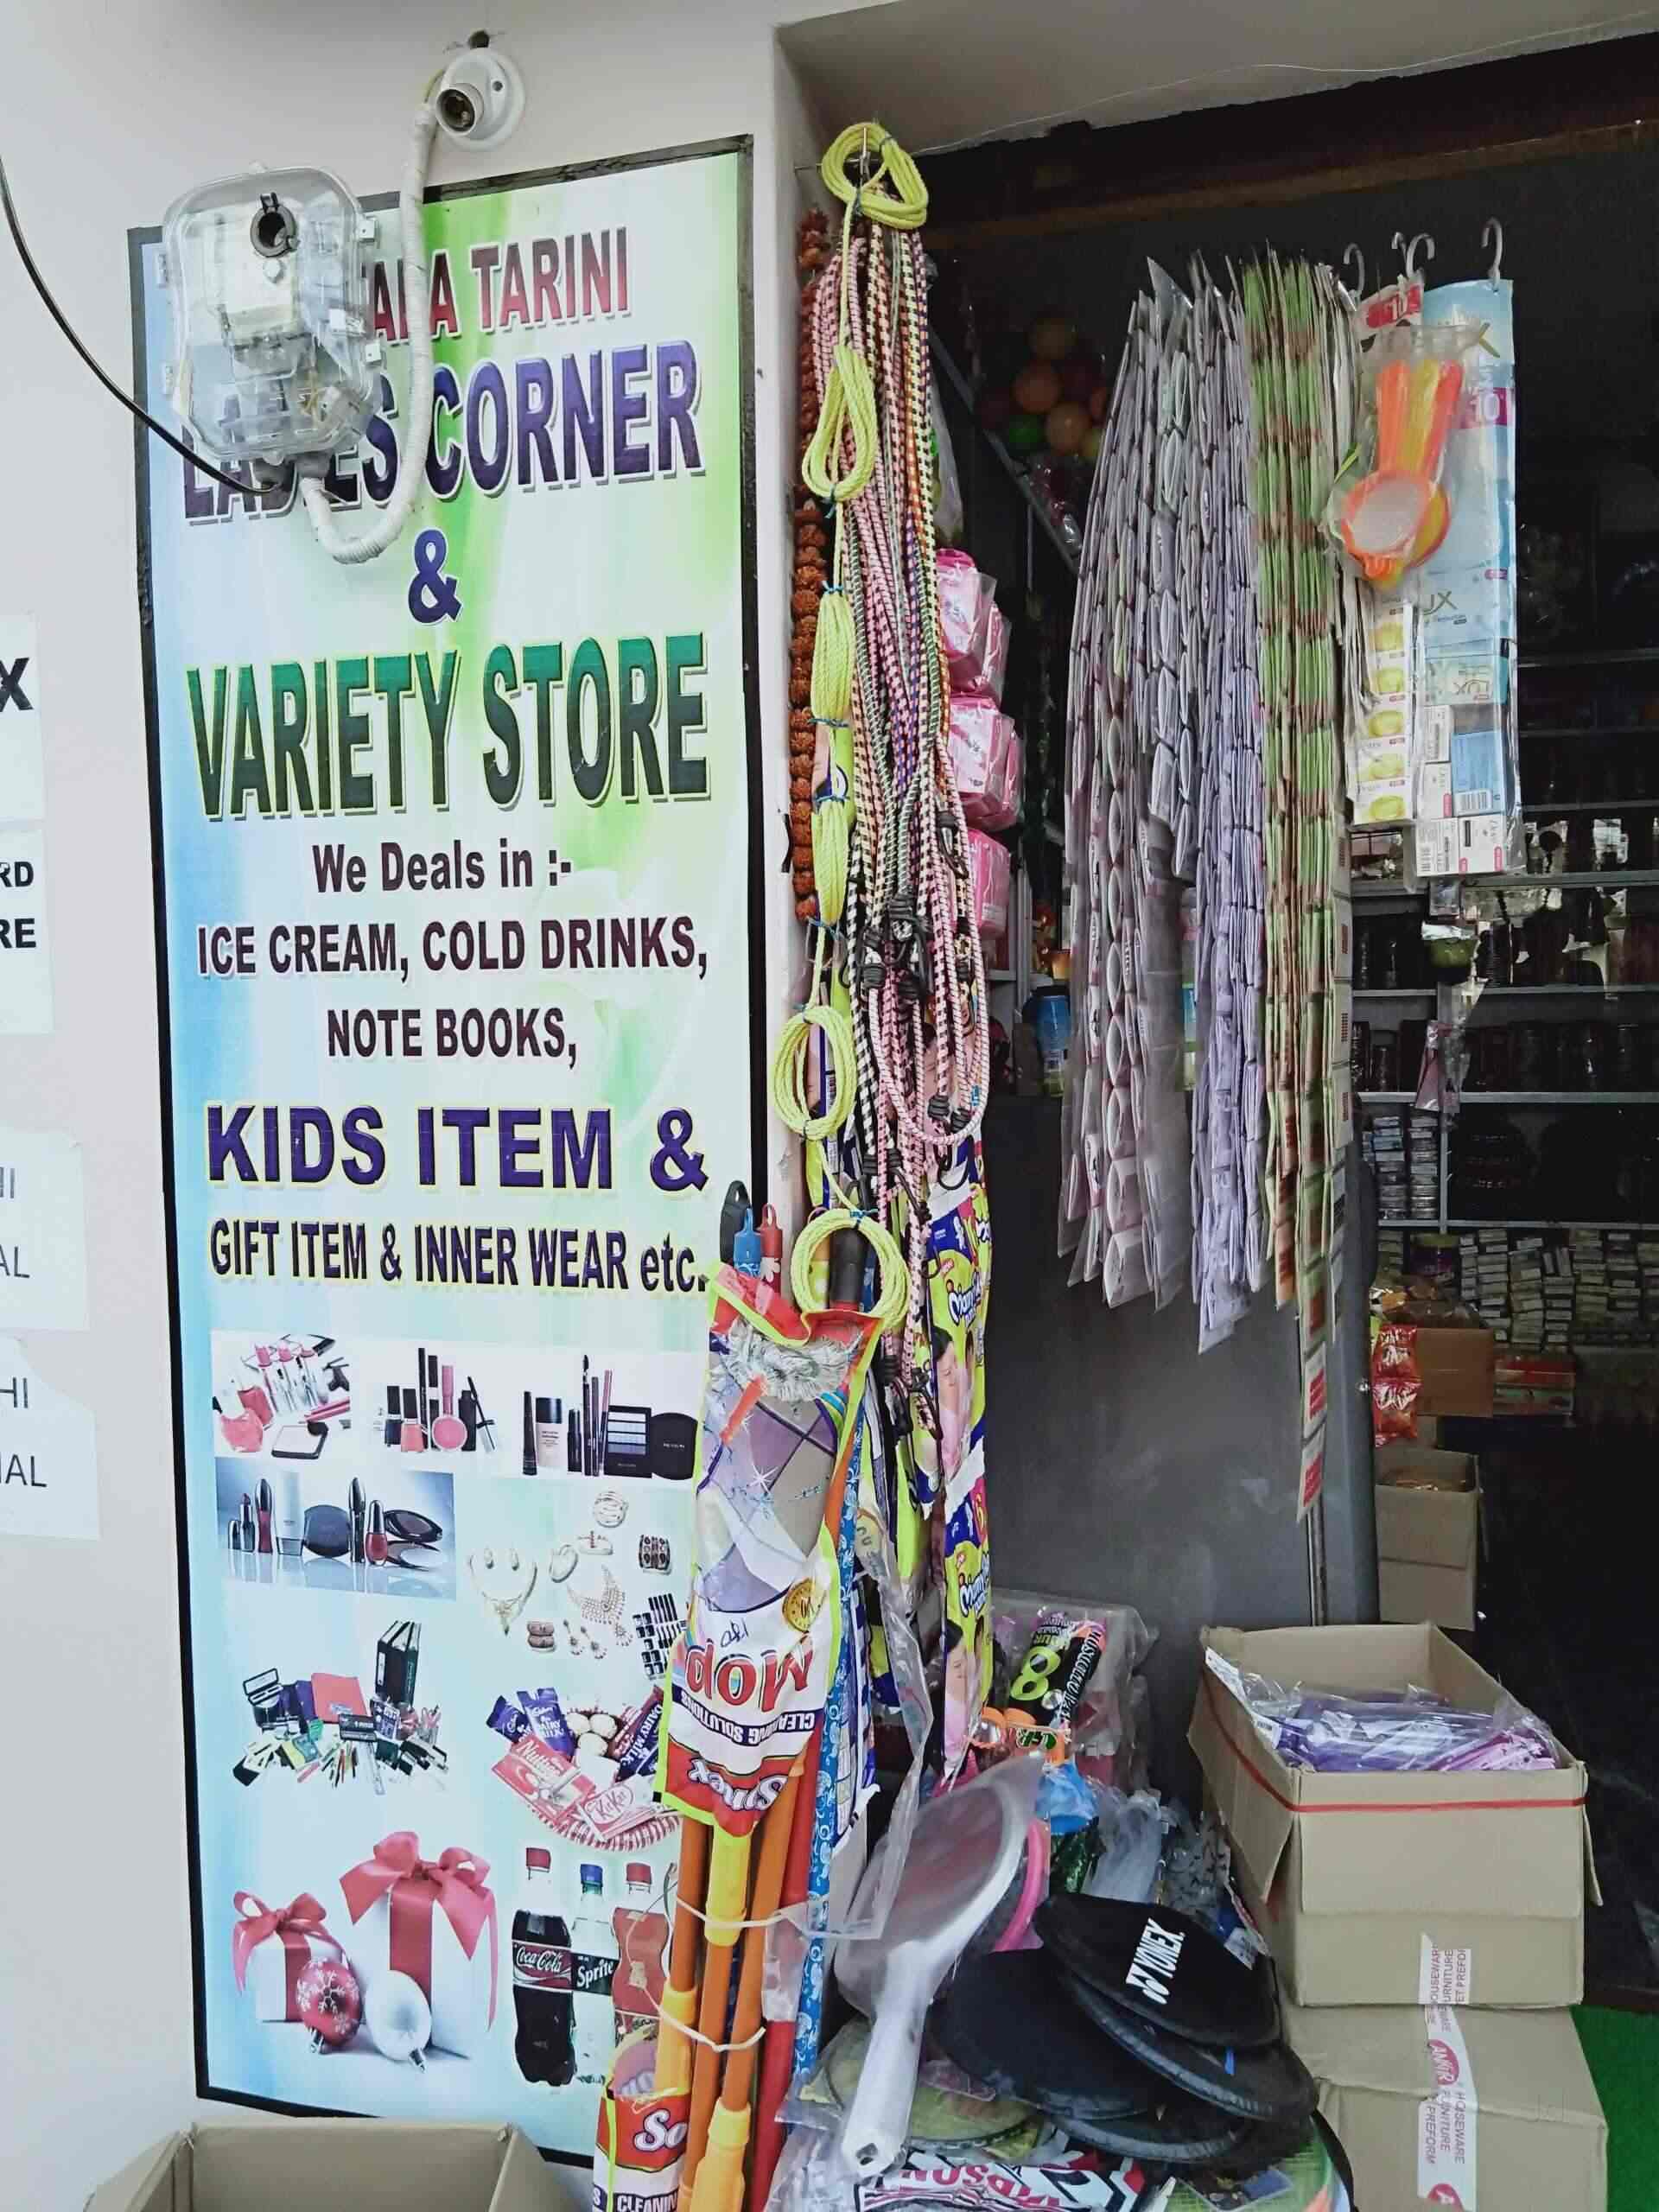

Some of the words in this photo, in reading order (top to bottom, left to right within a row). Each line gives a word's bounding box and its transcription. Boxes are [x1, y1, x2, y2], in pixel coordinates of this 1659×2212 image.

[470, 226, 629, 329] TARINI
[425, 341, 703, 497] CORNER
[408, 528, 462, 624] &
[186, 651, 459, 815] VARIETY
[481, 632, 708, 805] STORE
[312, 842, 366, 893] We
[381, 840, 484, 892] Deals
[499, 837, 533, 887] in
[198, 926, 256, 974] ICE
[269, 924, 409, 982] CREAM,
[422, 920, 526, 969] COLD
[540, 916, 707, 979] DRINKS,
[327, 1008, 423, 1058] NOTE
[436, 1007, 576, 1068] BOOKS,
[207, 1104, 386, 1185] KIDS
[416, 1107, 613, 1190] ITEM
[650, 1108, 709, 1192] &
[210, 1218, 281, 1276] GIFT
[291, 1221, 367, 1281] ITEM
[380, 1224, 403, 1282] &
[415, 1224, 519, 1287] INNER
[528, 1228, 629, 1291] WEAR
[640, 1232, 708, 1294] etc.
[576, 1958, 614, 1989] Sprite
